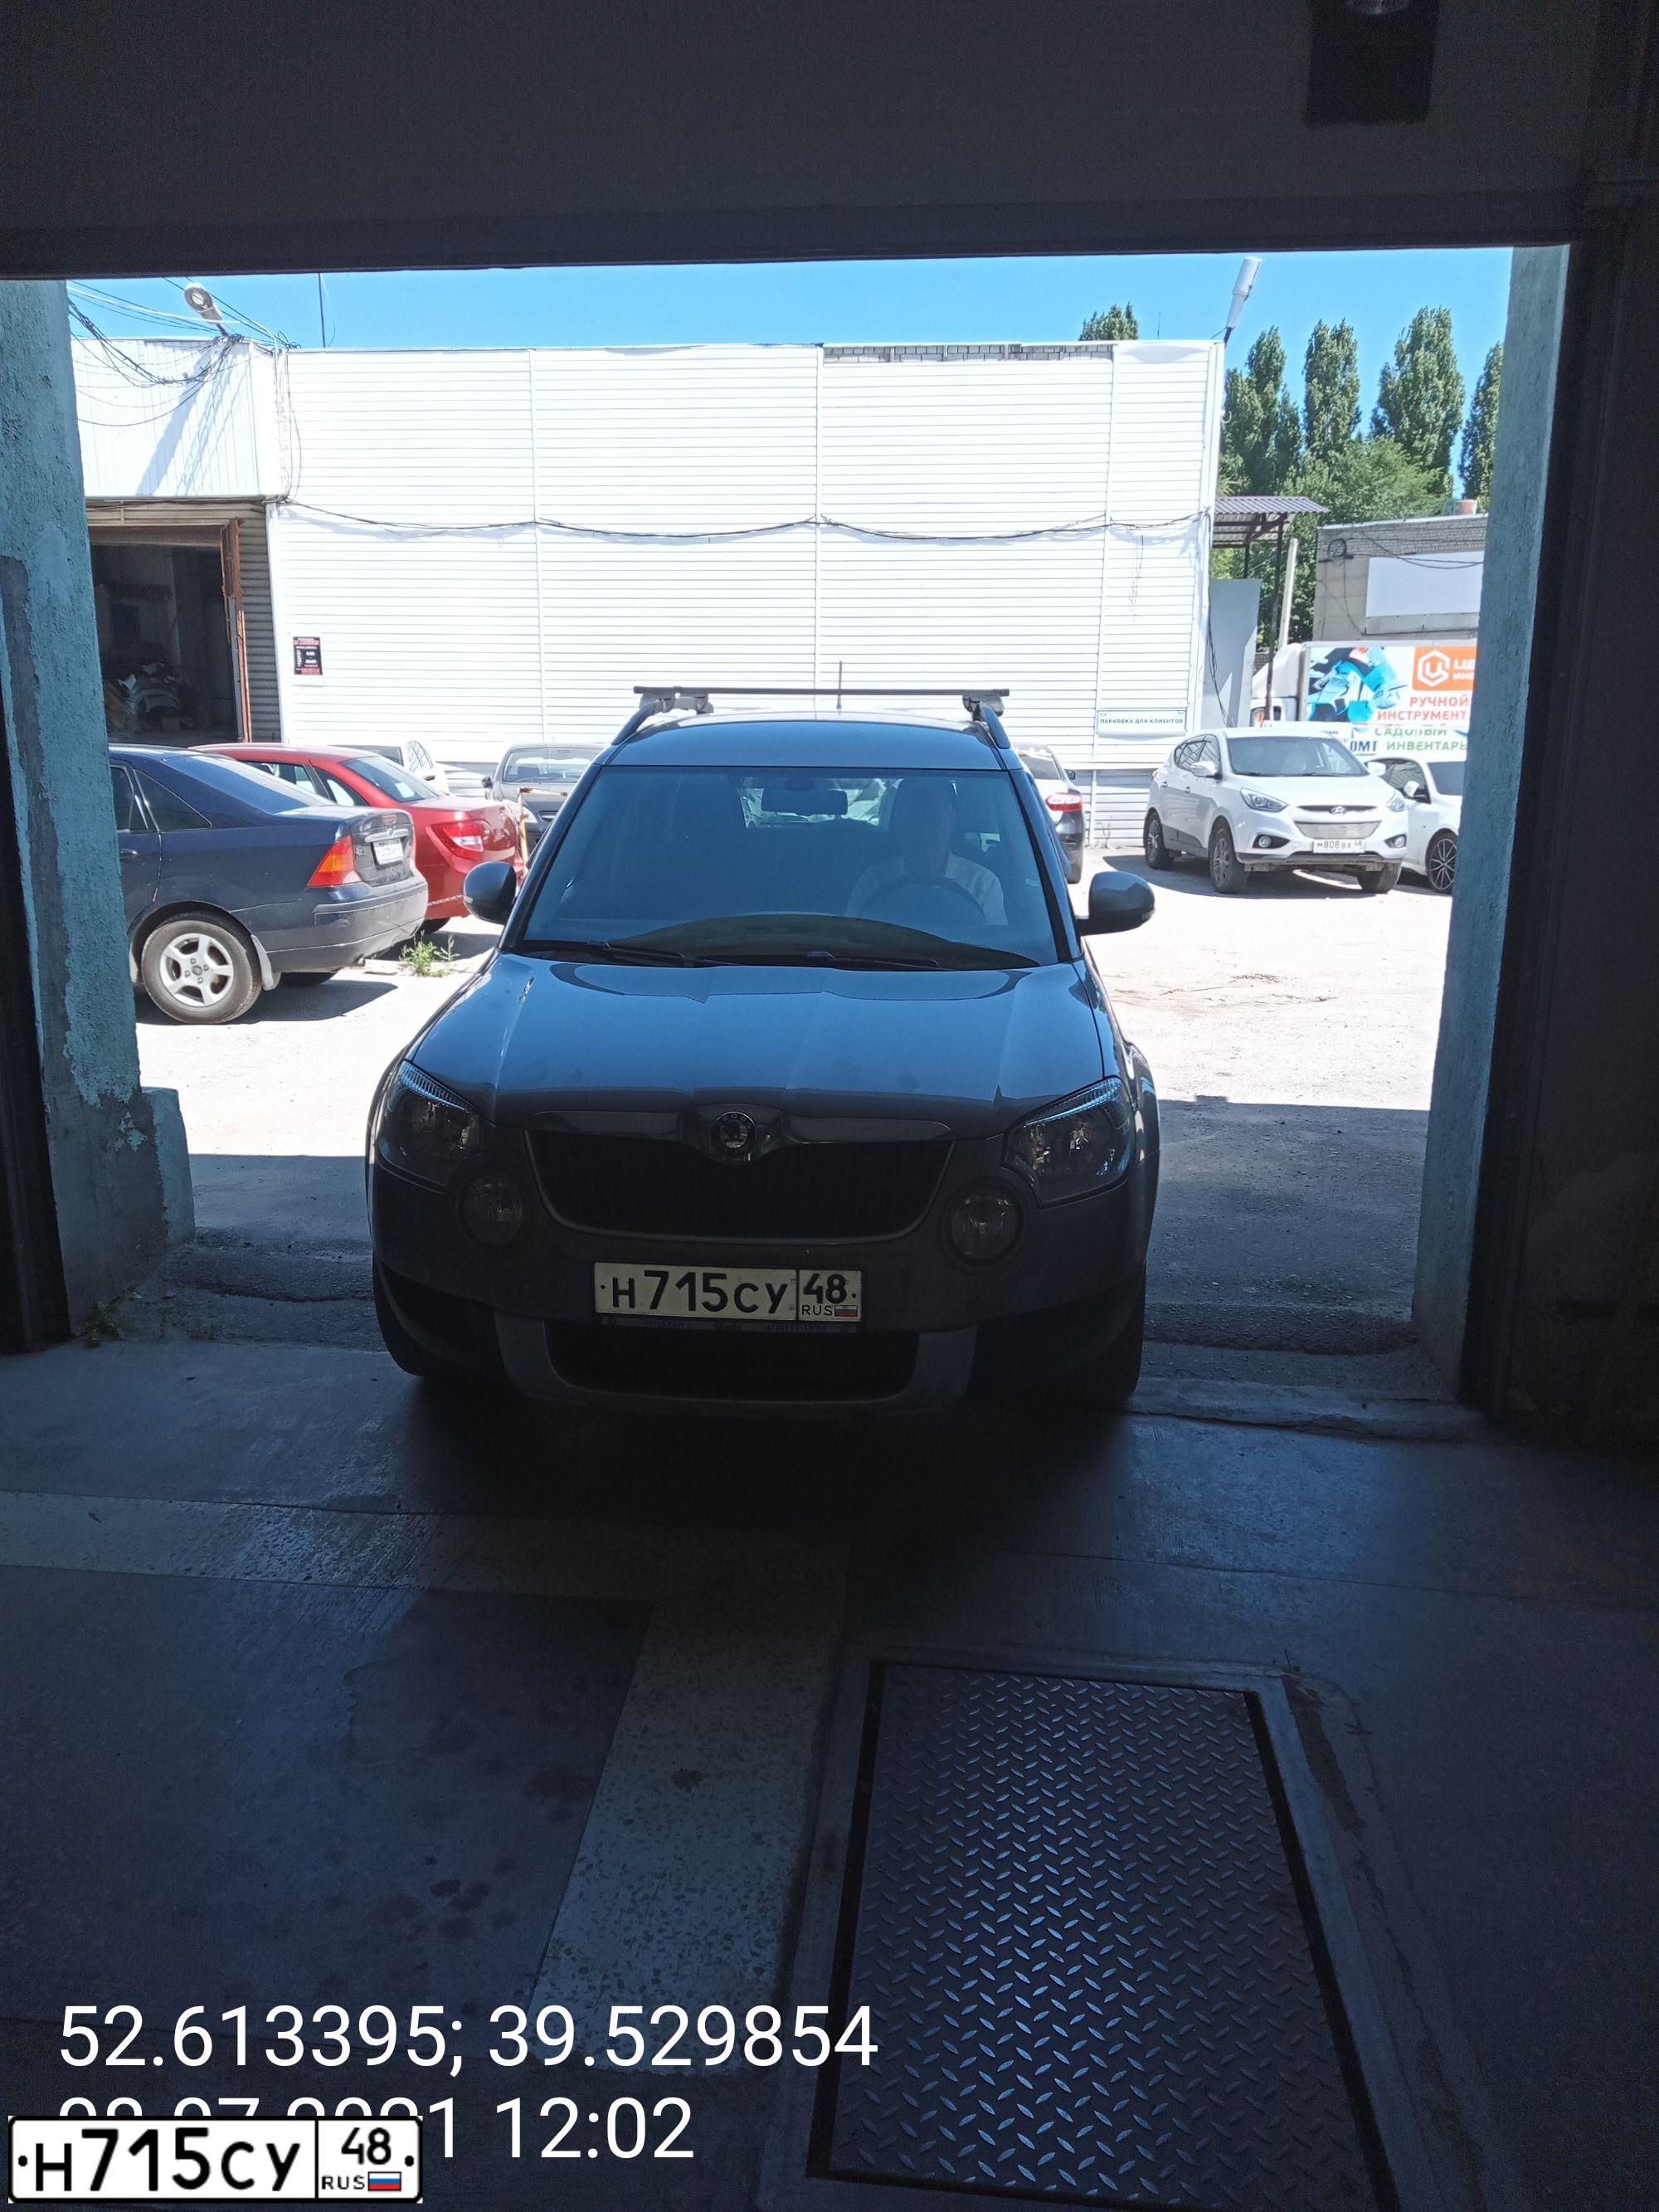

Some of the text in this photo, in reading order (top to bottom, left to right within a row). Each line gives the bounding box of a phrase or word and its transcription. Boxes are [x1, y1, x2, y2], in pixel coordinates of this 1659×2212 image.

[1409, 694, 1469, 707] РУЧНОЙ
[1377, 710, 1467, 720] ИНСТРУМЕНТ
[1386, 741, 1467, 751] ИНВЕНТАРЬ
[612, 1269, 848, 1314] Н715СУ 48
[801, 1305, 833, 1317] RUS
